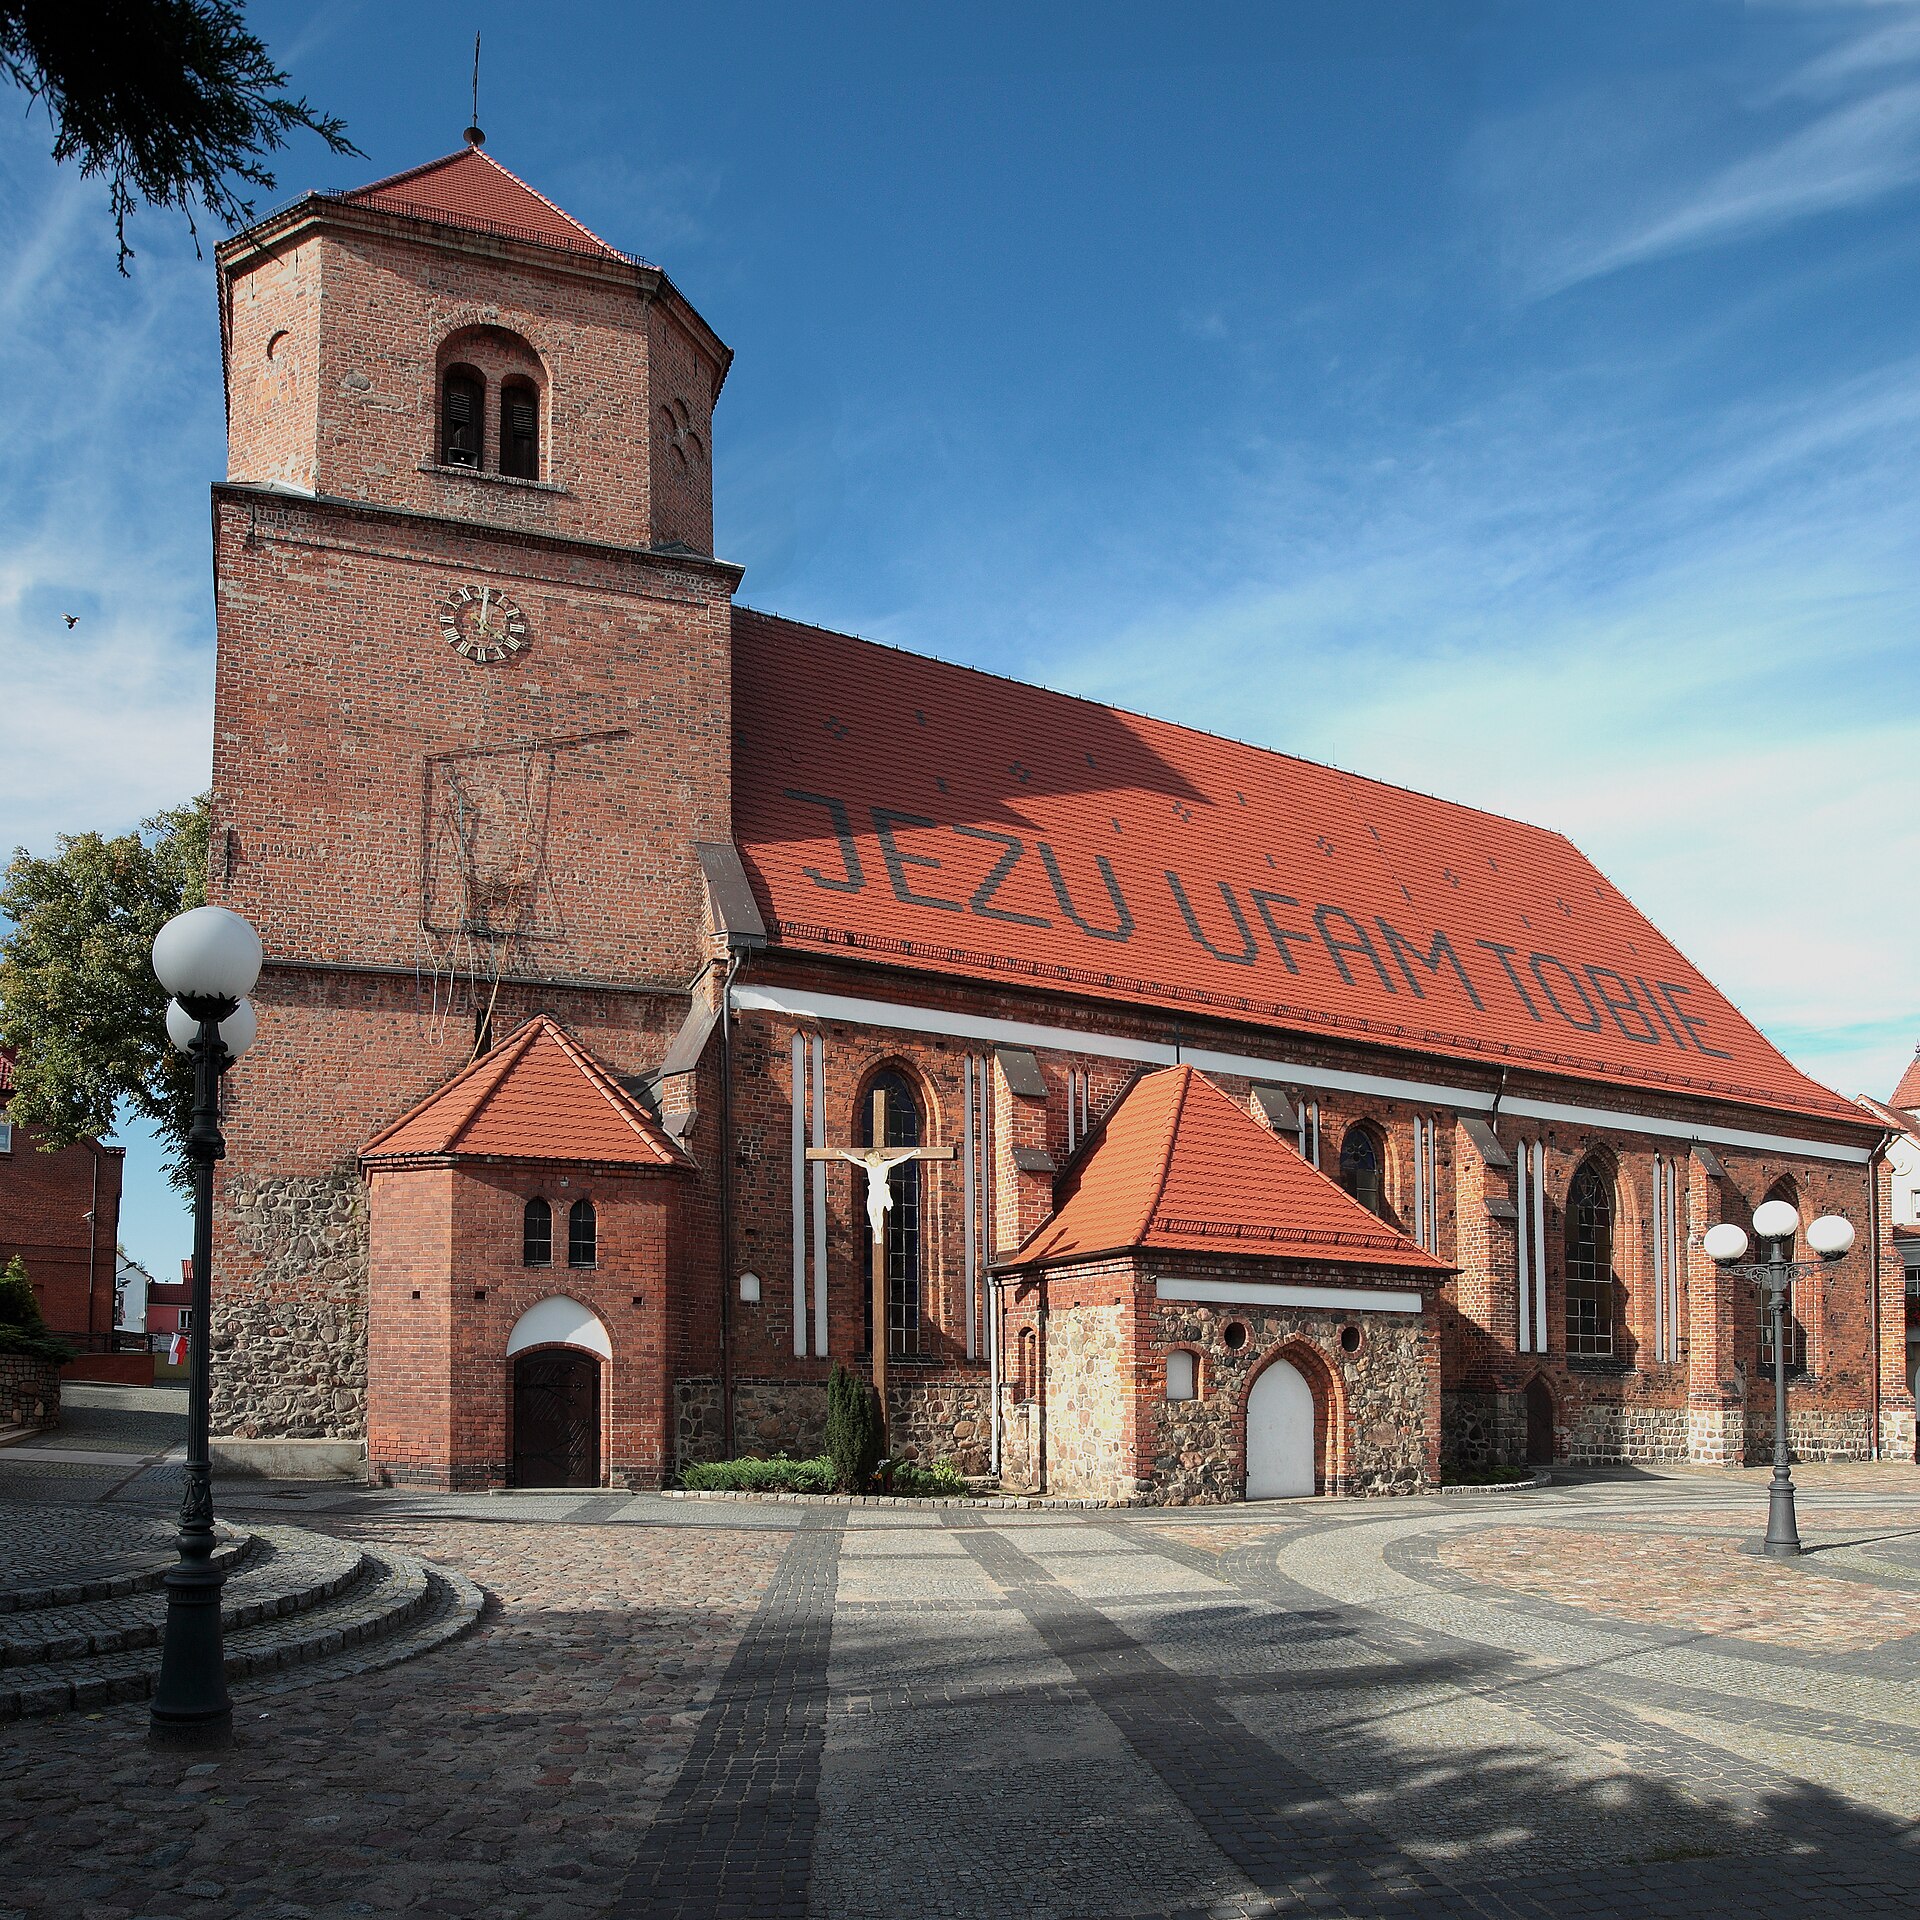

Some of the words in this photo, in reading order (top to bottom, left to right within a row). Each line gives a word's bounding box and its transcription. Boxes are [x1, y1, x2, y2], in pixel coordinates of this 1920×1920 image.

[509, 623, 525, 634] III
[504, 635, 521, 652] IIII
[783, 787, 1135, 943] JEZU
[1164, 869, 1486, 1012] UFAM
[1476, 938, 1733, 1060] TOBIE
